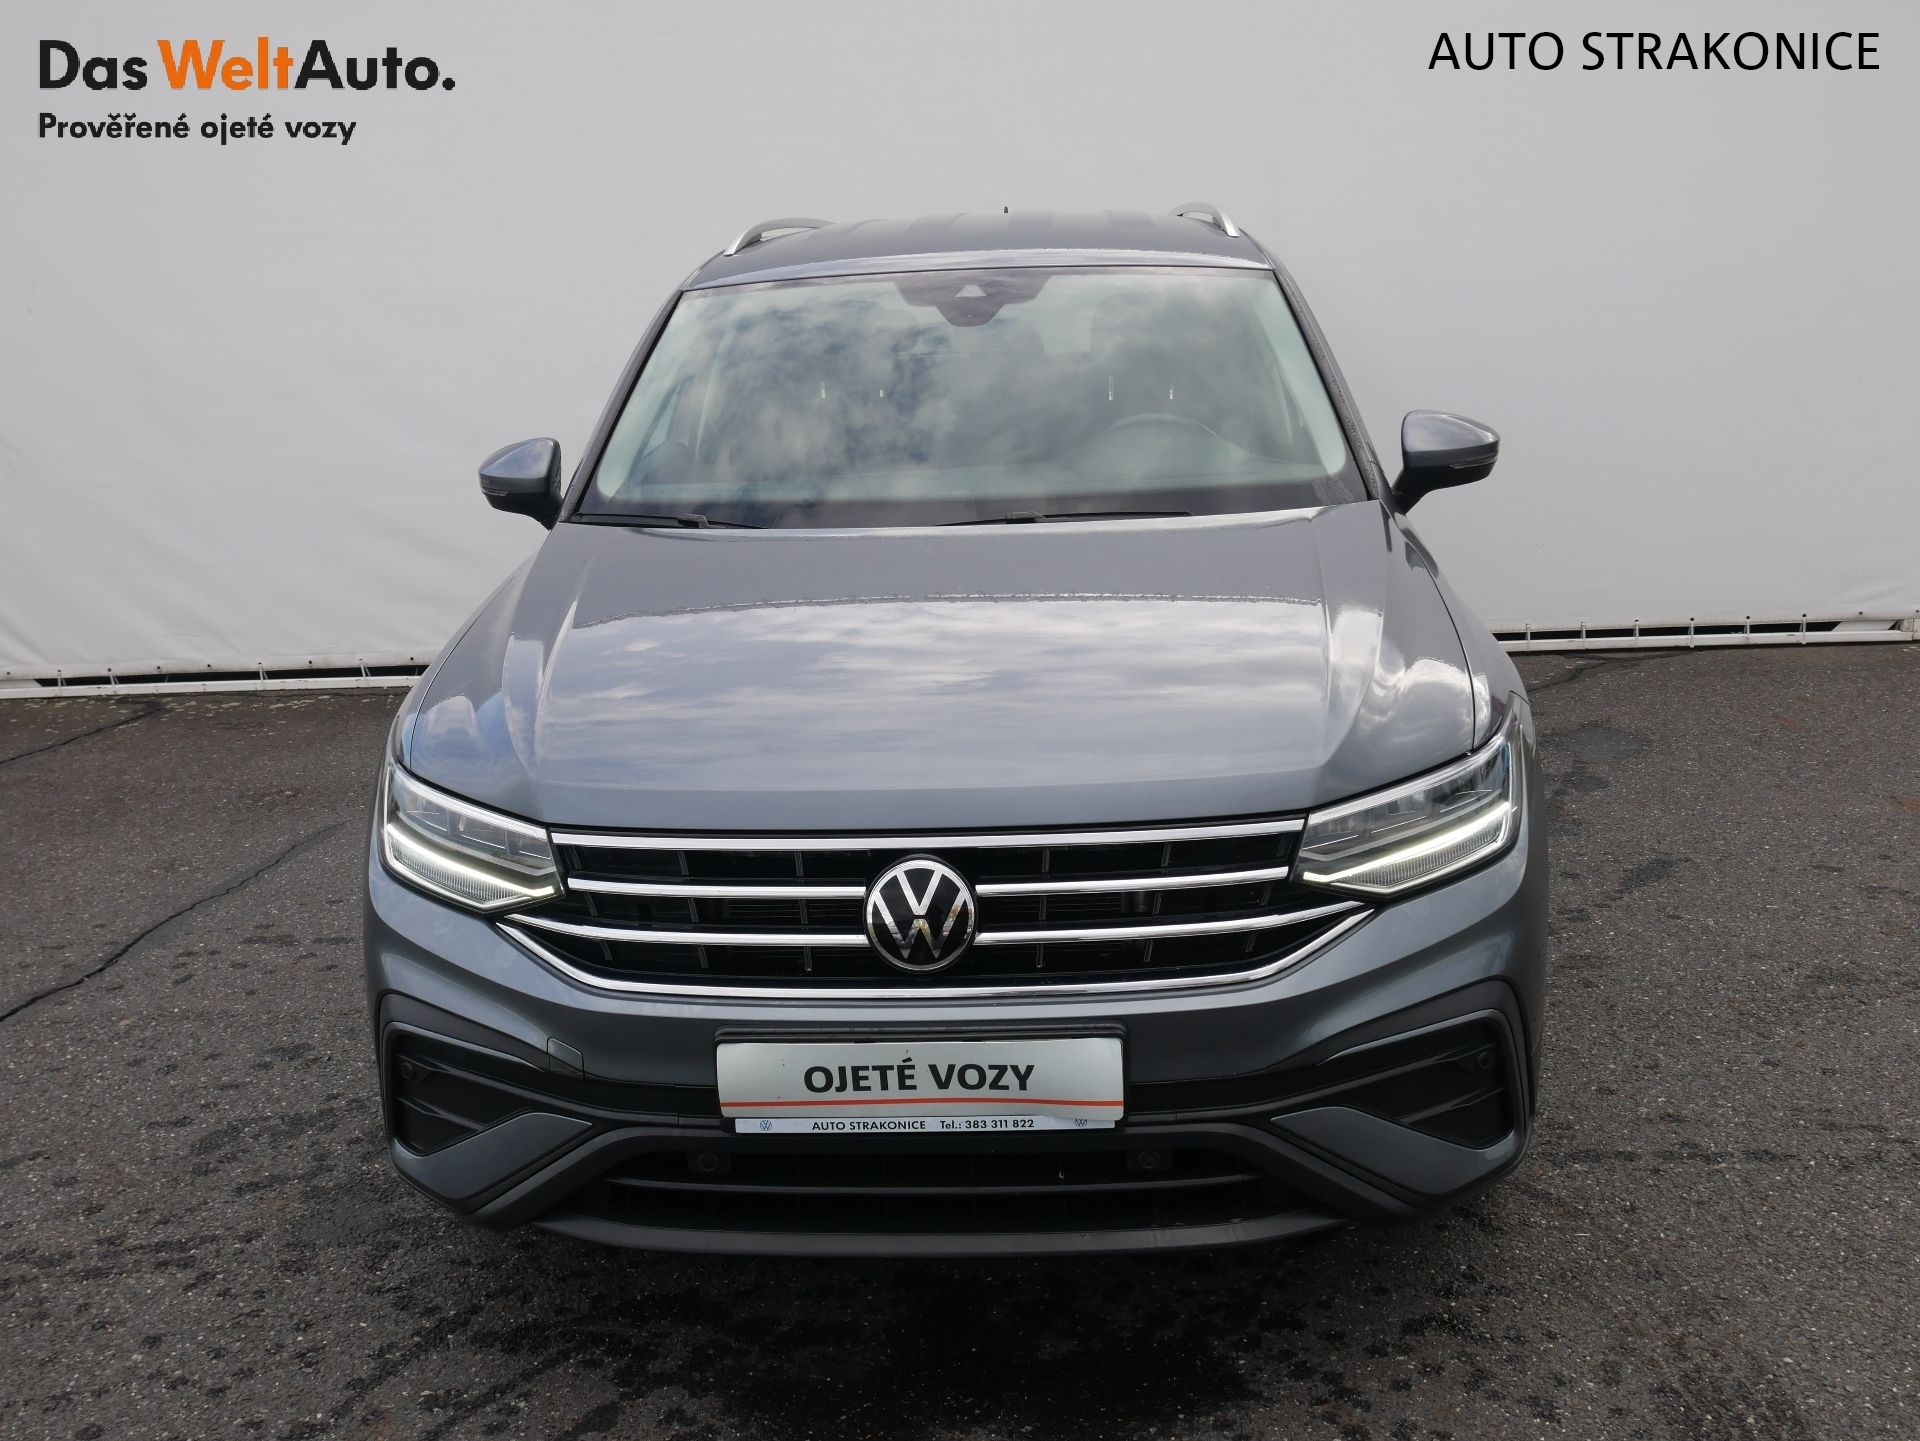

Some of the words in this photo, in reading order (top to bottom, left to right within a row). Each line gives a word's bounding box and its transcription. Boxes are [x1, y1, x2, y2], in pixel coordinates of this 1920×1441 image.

[803, 1056, 918, 1093] OJETÉ
[927, 1063, 1035, 1092] VOZY
[811, 1121, 846, 1131] AUTO
[849, 1120, 926, 1130] STRAKONICE
[940, 1120, 962, 1130] Tel.:
[964, 1120, 988, 1129] 383
[991, 1119, 1008, 1129] 311
[1012, 1119, 1035, 1129] 822
